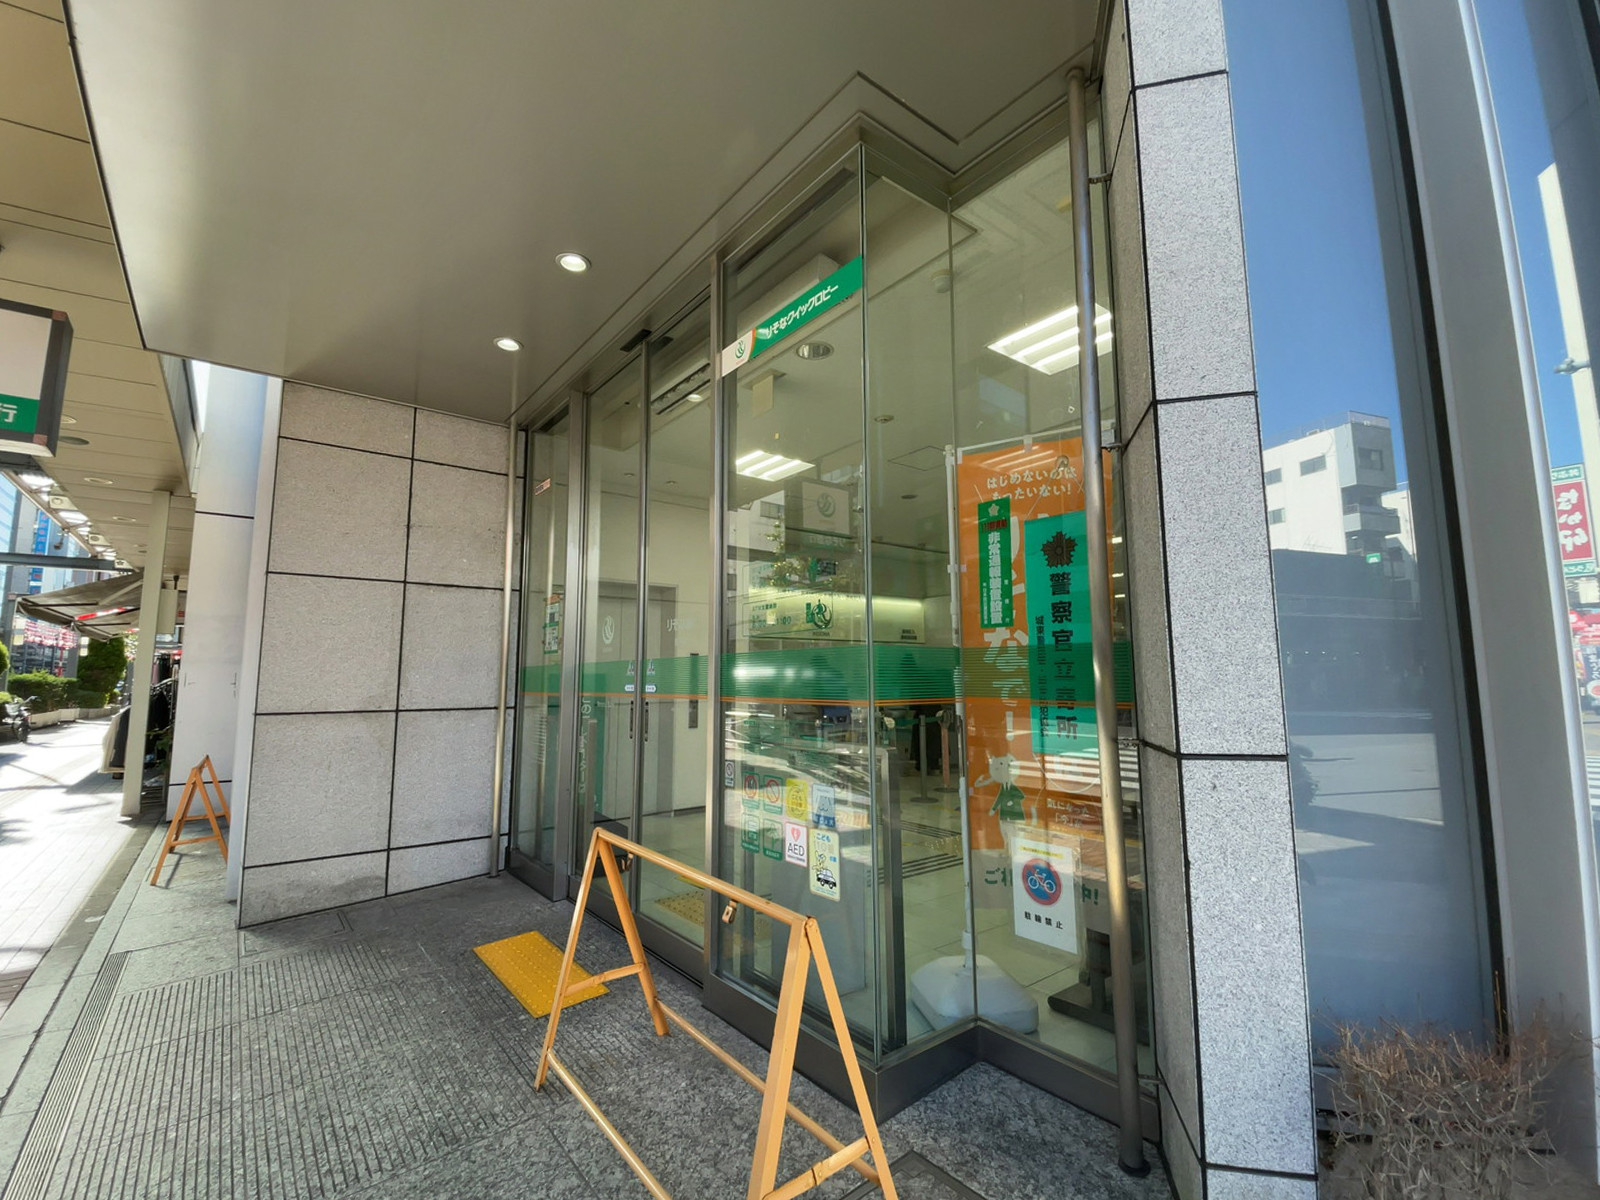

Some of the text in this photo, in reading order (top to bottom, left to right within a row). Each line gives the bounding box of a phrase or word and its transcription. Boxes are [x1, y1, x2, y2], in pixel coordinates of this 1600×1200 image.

[767, 285, 839, 339] りそなクイックロビー
[987, 467, 1077, 489] はじめないのは
[1049, 571, 1079, 740] 警察官立寄所
[816, 833, 831, 843] こども
[787, 843, 805, 857] AED
[1024, 911, 1063, 930] 駐輪禁止
